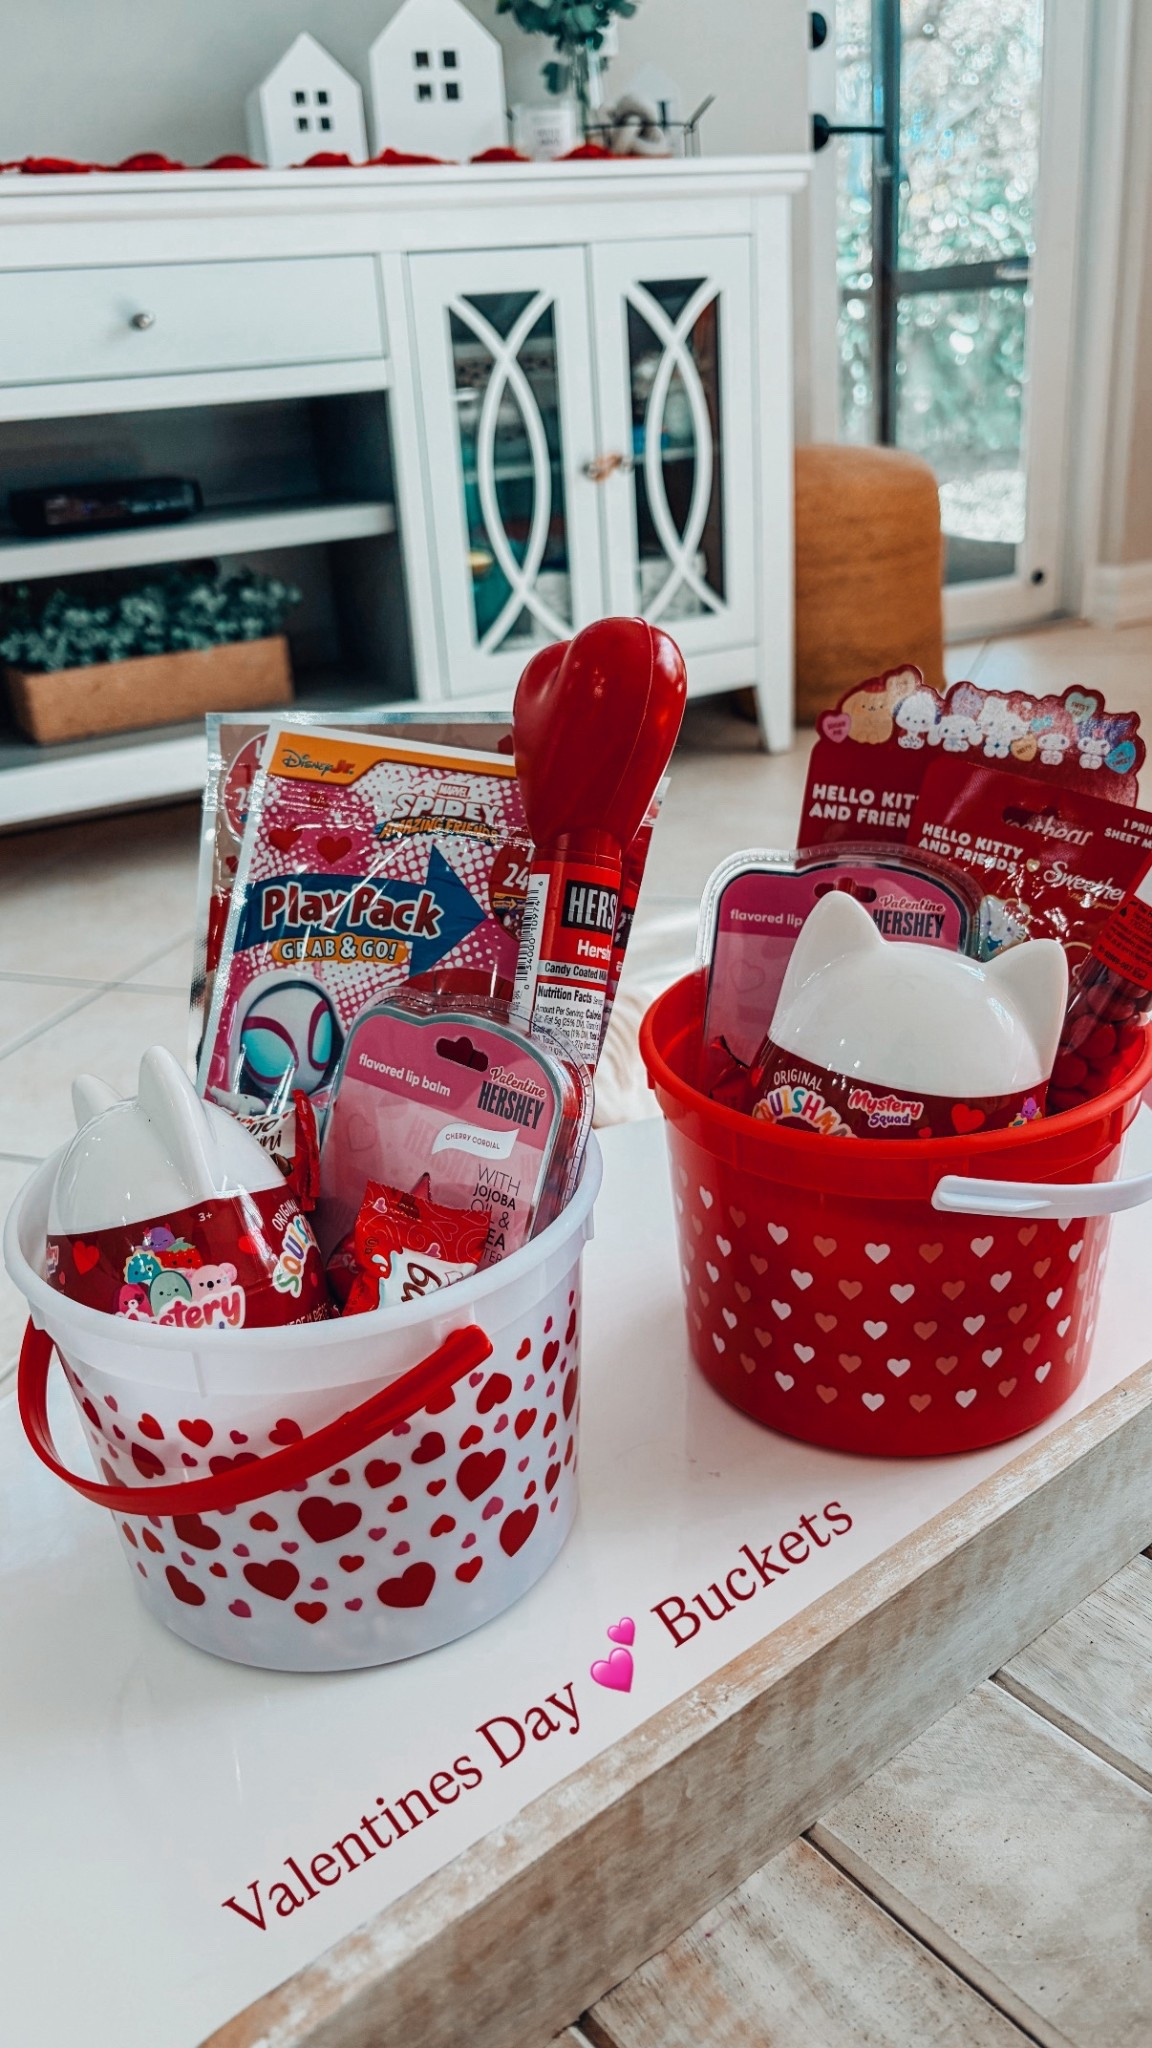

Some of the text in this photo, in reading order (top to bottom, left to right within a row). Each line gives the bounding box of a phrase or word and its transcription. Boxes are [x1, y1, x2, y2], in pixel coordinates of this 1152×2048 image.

[283, 749, 334, 776] Disney
[440, 784, 469, 798] MARVEL
[812, 783, 919, 810] HELLO KIT
[391, 793, 500, 825] SPIDEY
[809, 802, 911, 829] AND FRIEN
[379, 817, 499, 845] AMAZING FRIENDS
[1104, 827, 1141, 845] SHEET
[1123, 819, 1129, 829] 1
[922, 822, 1024, 860] HELLO KITTY
[918, 837, 1017, 874] AND FRIENDS
[503, 863, 529, 890] 24
[262, 883, 444, 938] Play Pack
[530, 900, 540, 932] 10974
[567, 886, 618, 930] HERS
[879, 894, 945, 912] Valentine
[730, 909, 803, 928] flavored lip
[873, 909, 945, 939] HERSHEY
[281, 934, 397, 961] GRAB & GO!
[526, 938, 536, 971] 34000
[545, 962, 571, 976] Candy
[573, 966, 598, 980] Coated
[537, 985, 572, 1001] Nutrition
[574, 990, 592, 1003] Facts
[556, 1006, 565, 1015] Per
[359, 1054, 450, 1097] flavored lip balm
[490, 1066, 546, 1098] Valentine
[774, 1068, 822, 1091] ORIGINAL
[477, 1080, 545, 1130] HERSHEY
[849, 1090, 922, 1119] Mystery
[869, 1112, 911, 1127] Squad
[445, 1133, 501, 1150] CHERRY CORDIAL
[479, 1164, 521, 1197] WITH
[473, 1183, 516, 1211] JOJOBA
[198, 1212, 213, 1222] 3+
[498, 1212, 510, 1230] &
[486, 1229, 505, 1251] EA
